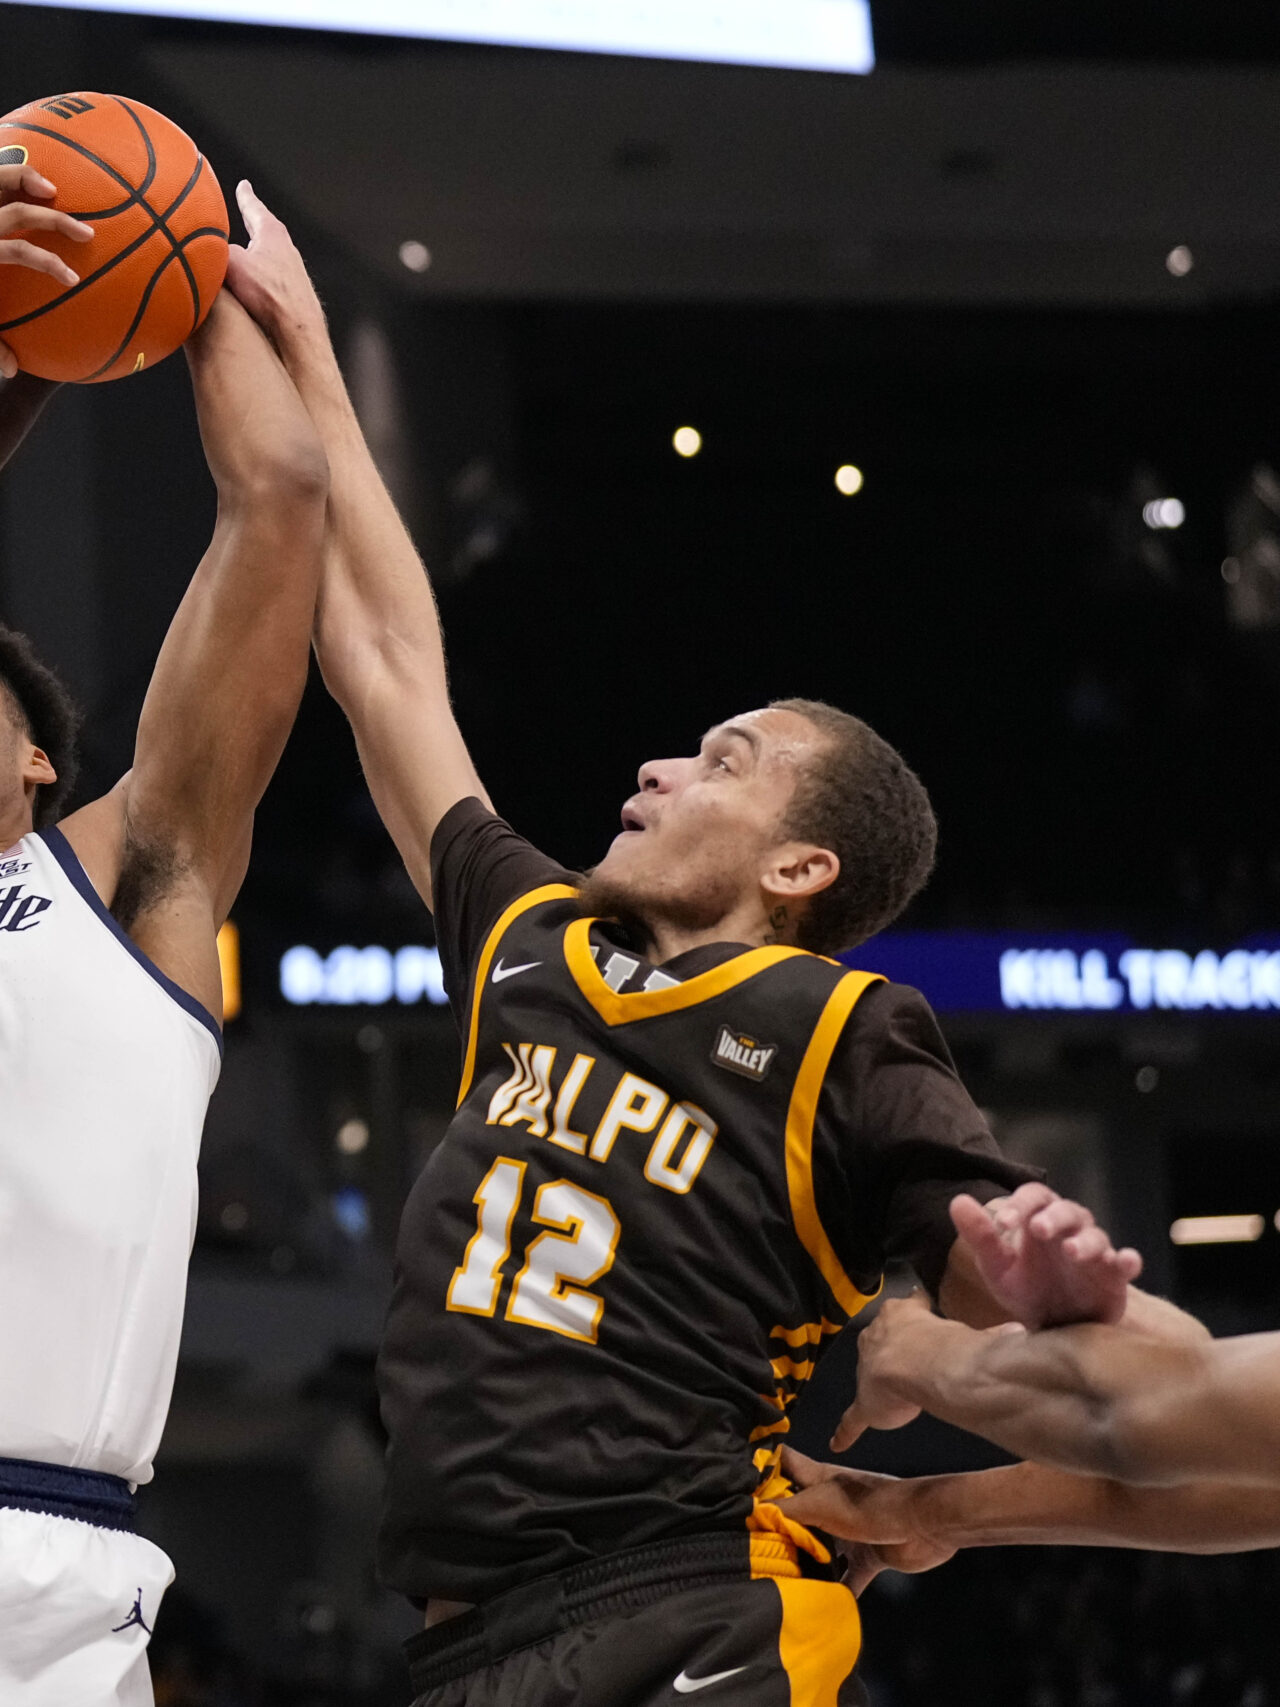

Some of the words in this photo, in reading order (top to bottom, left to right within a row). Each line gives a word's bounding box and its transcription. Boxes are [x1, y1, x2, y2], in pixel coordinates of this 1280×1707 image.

[999, 949, 1122, 1008] KILL
[717, 1028, 775, 1073] VALLEY
[485, 1042, 718, 1195] VALPO
[446, 1156, 621, 1345] 12
